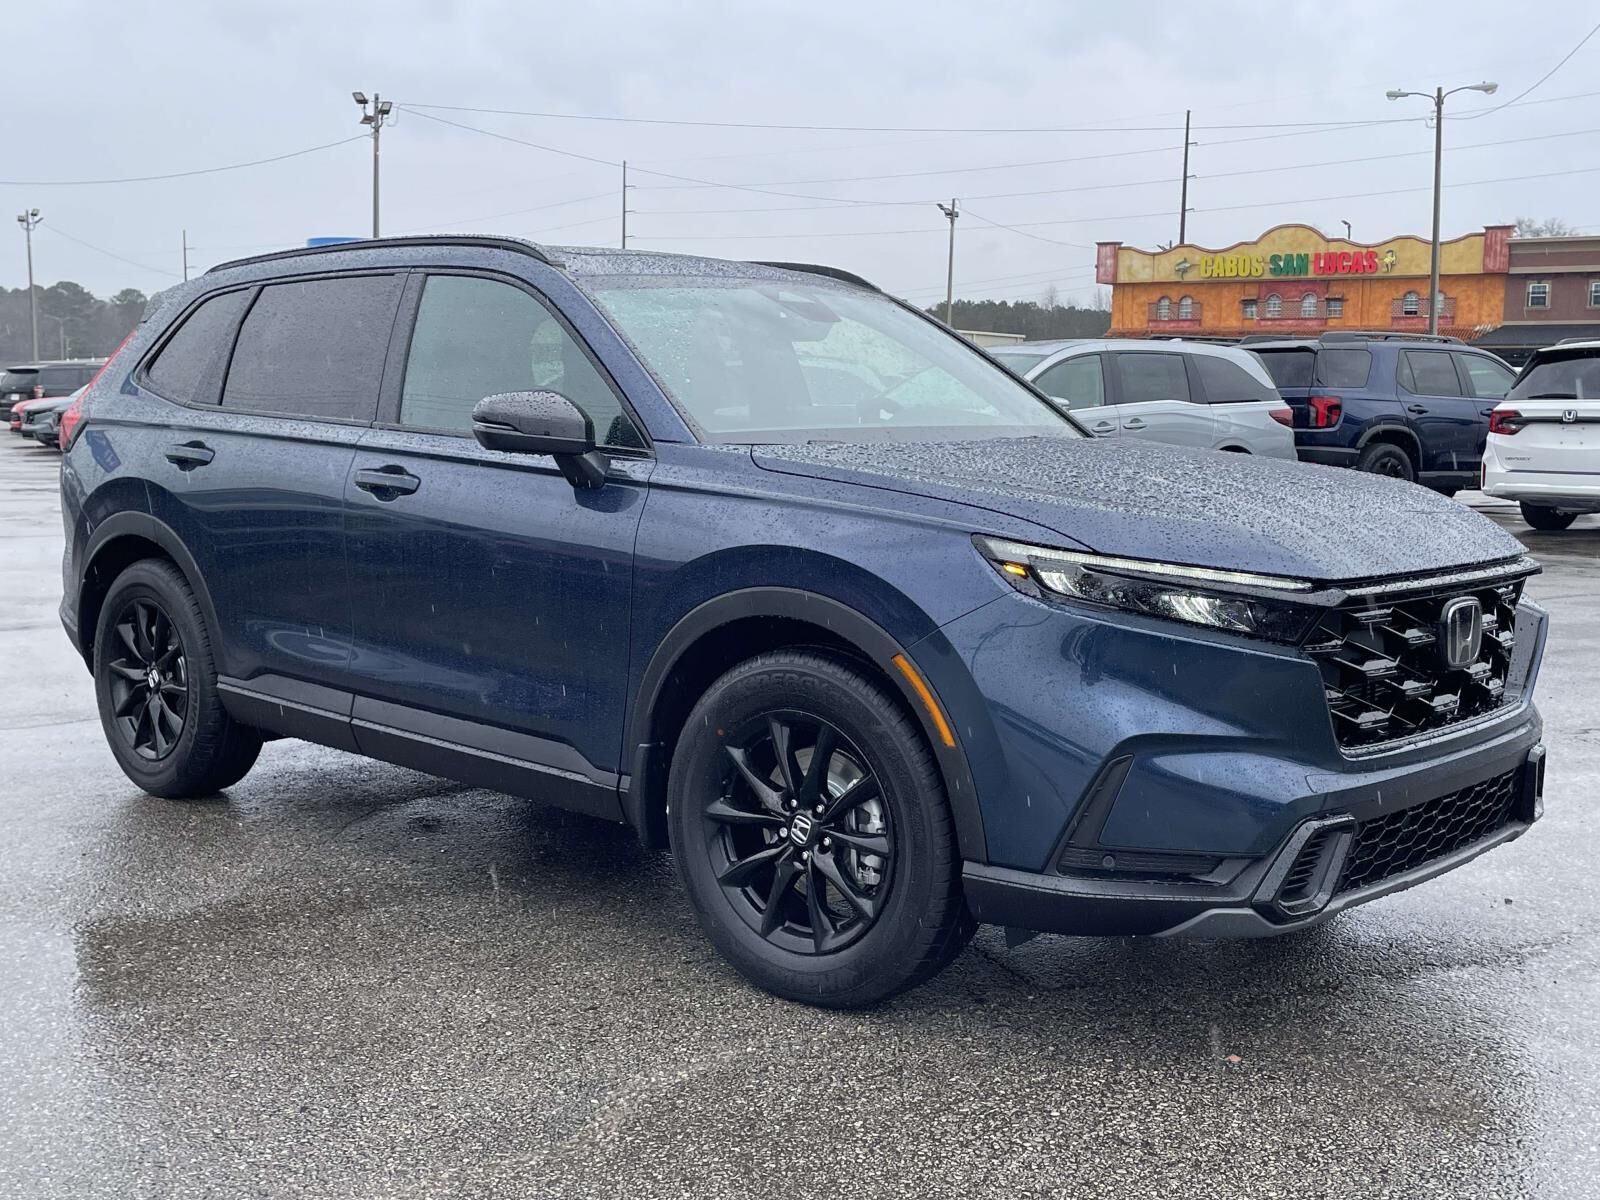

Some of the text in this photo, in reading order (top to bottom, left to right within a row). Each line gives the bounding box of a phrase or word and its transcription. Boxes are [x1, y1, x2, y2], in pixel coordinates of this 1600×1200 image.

[1200, 251, 1378, 278] CABOS SAN LUCAS
